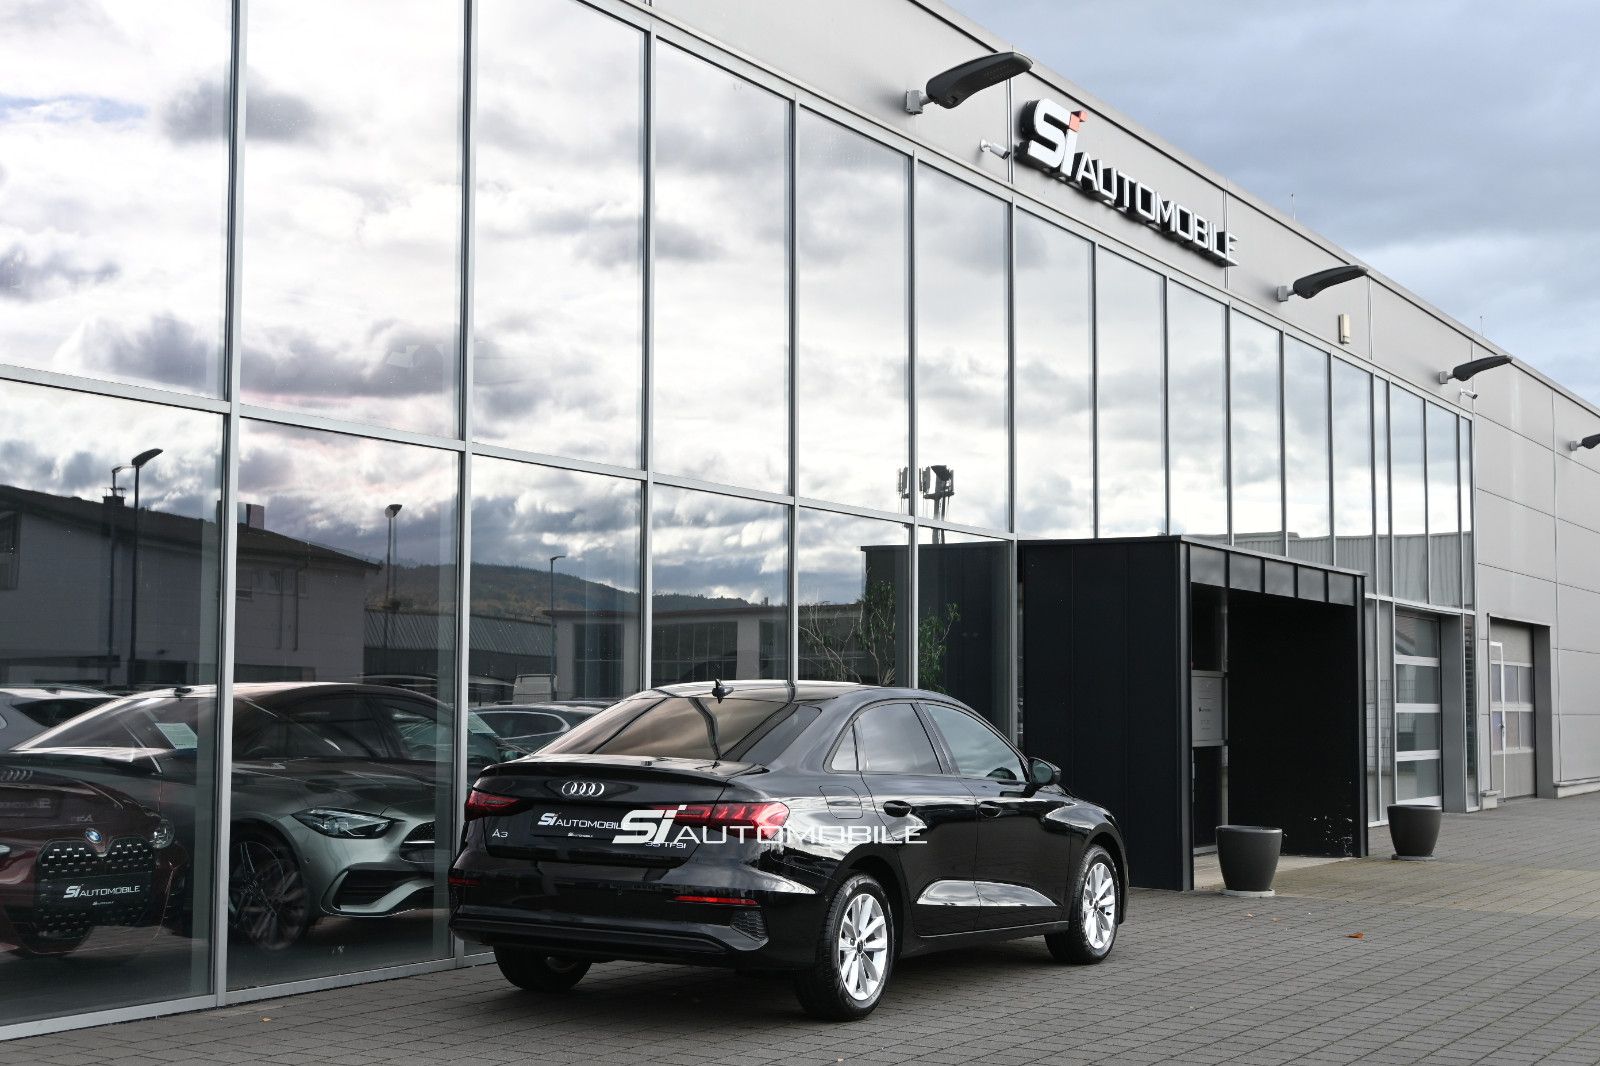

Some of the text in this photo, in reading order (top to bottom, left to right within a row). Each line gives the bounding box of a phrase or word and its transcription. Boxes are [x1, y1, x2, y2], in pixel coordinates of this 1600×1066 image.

[1075, 152, 1239, 267] AUTOMOBILE
[555, 819, 622, 830] AUTOMOBIL
[491, 828, 509, 838] A3
[79, 885, 140, 898] AUTOMOBILE
